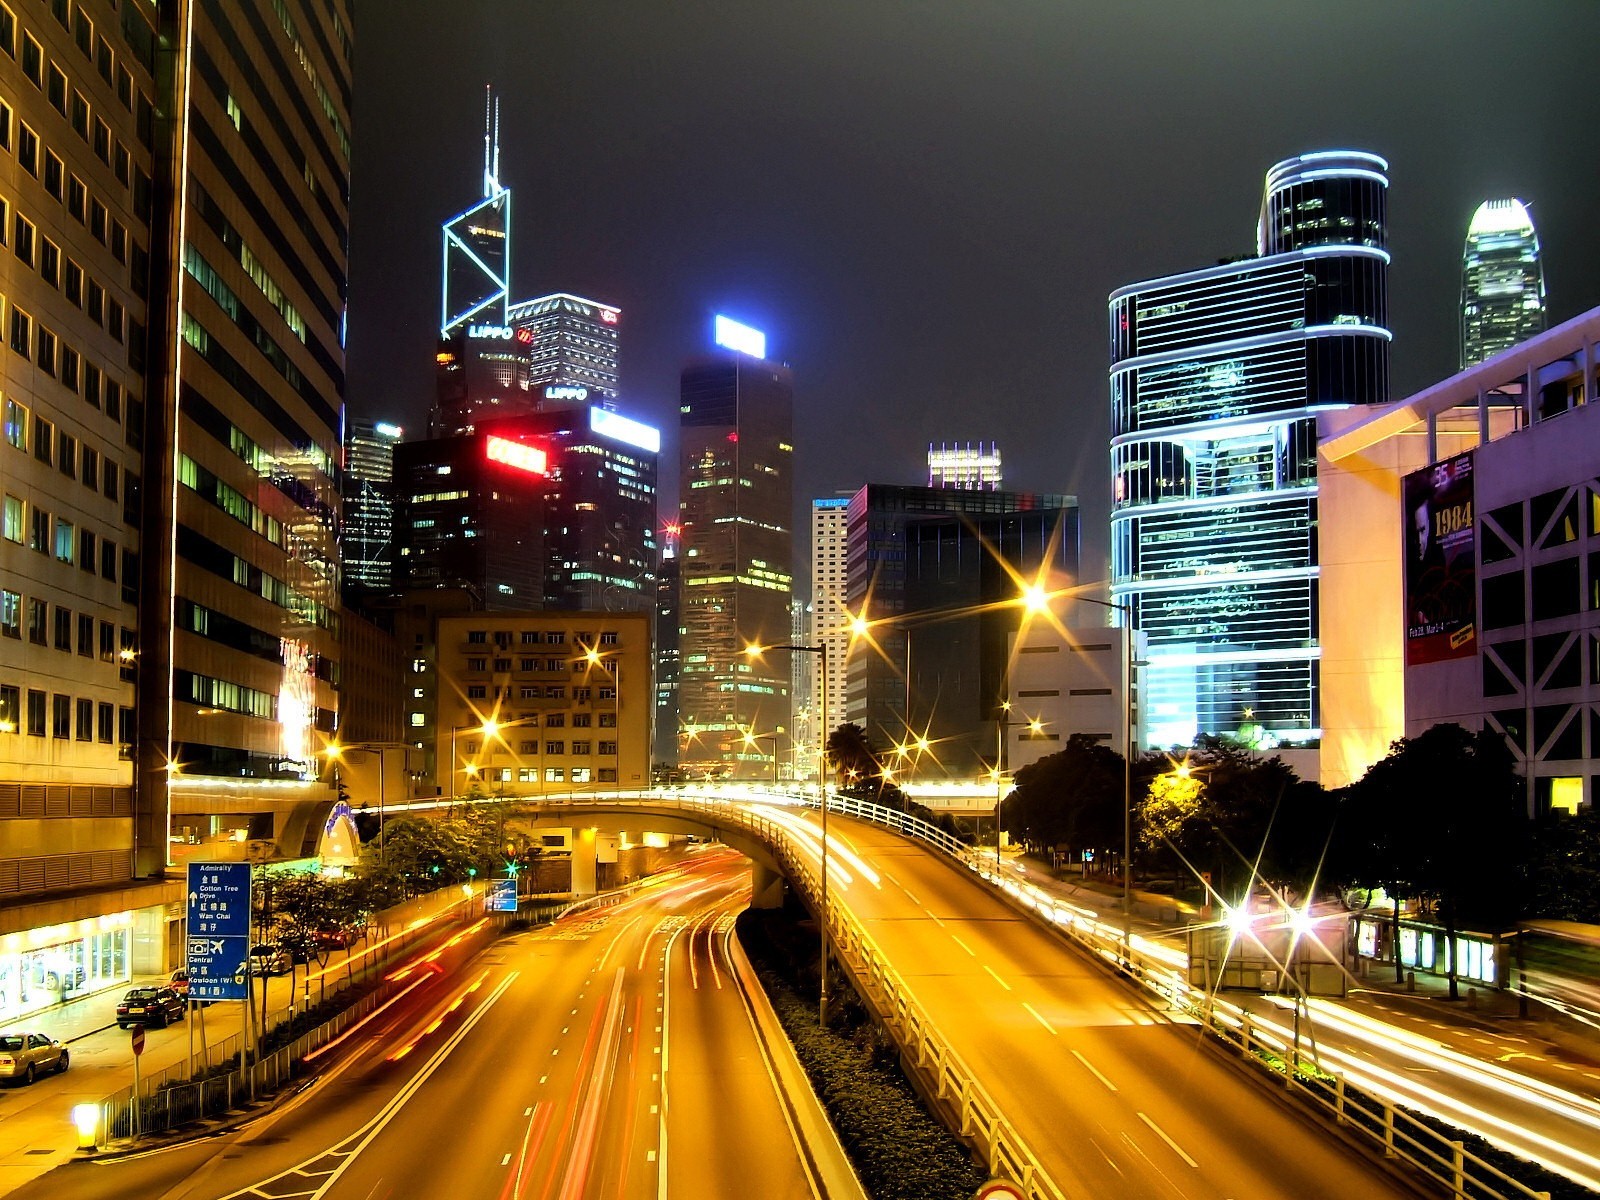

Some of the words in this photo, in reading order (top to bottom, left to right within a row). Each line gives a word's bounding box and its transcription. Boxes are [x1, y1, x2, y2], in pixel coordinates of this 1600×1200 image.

[469, 325, 513, 339] LIPPO
[545, 387, 587, 400] LIPPO
[1435, 501, 1472, 537] 1984
[188, 976, 218, 984] Kowloon
